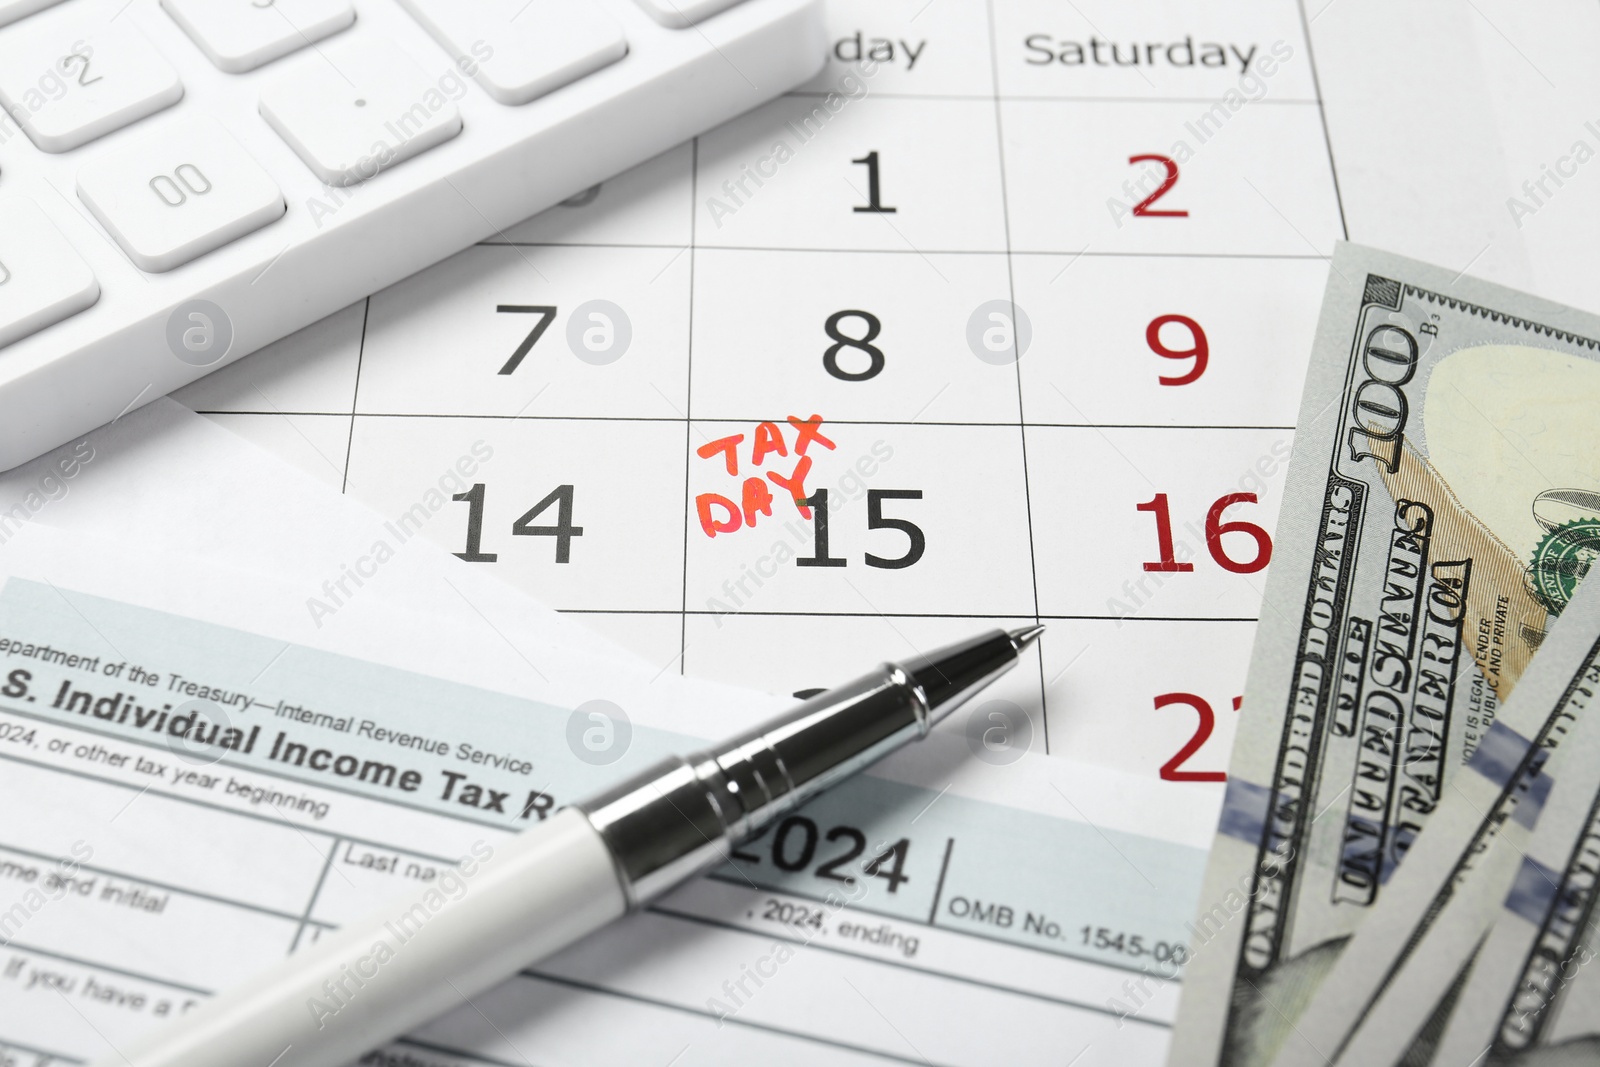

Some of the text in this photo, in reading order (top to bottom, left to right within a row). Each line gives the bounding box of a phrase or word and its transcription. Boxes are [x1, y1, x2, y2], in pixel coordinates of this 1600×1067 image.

[63, 53, 103, 87] 2
[826, 29, 927, 71] day
[1024, 33, 1258, 75] Saturday
[149, 163, 212, 208] 00
[851, 151, 897, 214] 1
[1128, 154, 1190, 218] 2
[496, 305, 557, 376] 7
[822, 309, 885, 381] 8
[1145, 314, 1209, 387] 9
[1347, 323, 1419, 475] 100
[695, 414, 836, 476] TAX
[451, 484, 584, 563] 14
[695, 455, 813, 538] DAY
[796, 488, 926, 569] 15
[1136, 492, 1273, 574] 16
[1303, 484, 1354, 660] DOLLARS
[1475, 617, 1492, 669] TENDER
[1492, 594, 1509, 646] PRIVATE
[1331, 616, 1373, 738] THE
[1403, 557, 1473, 801] AMERICA
[1469, 672, 1486, 714] LEGAL
[1489, 645, 1502, 678] AND
[0, 637, 101, 674] epartment
[103, 660, 124, 677] of
[128, 664, 160, 687] the
[357, 720, 450, 756] Revenue
[455, 743, 533, 775] Service
[1331, 690, 1404, 907] UNITED
[1370, 498, 1435, 694] STATES
[1482, 677, 1500, 727] PUBLIC
[52, 680, 261, 755] Individual
[269, 731, 423, 793] Income
[440, 770, 510, 814] Tax
[1153, 692, 1245, 783] 2
[0, 722, 330, 821] 024, or other tax year beginning
[0, 861, 171, 915] me and initial
[343, 842, 444, 884] Last na
[838, 921, 920, 958] ending
[947, 896, 1015, 929] OMB
[1023, 910, 1067, 942] No.
